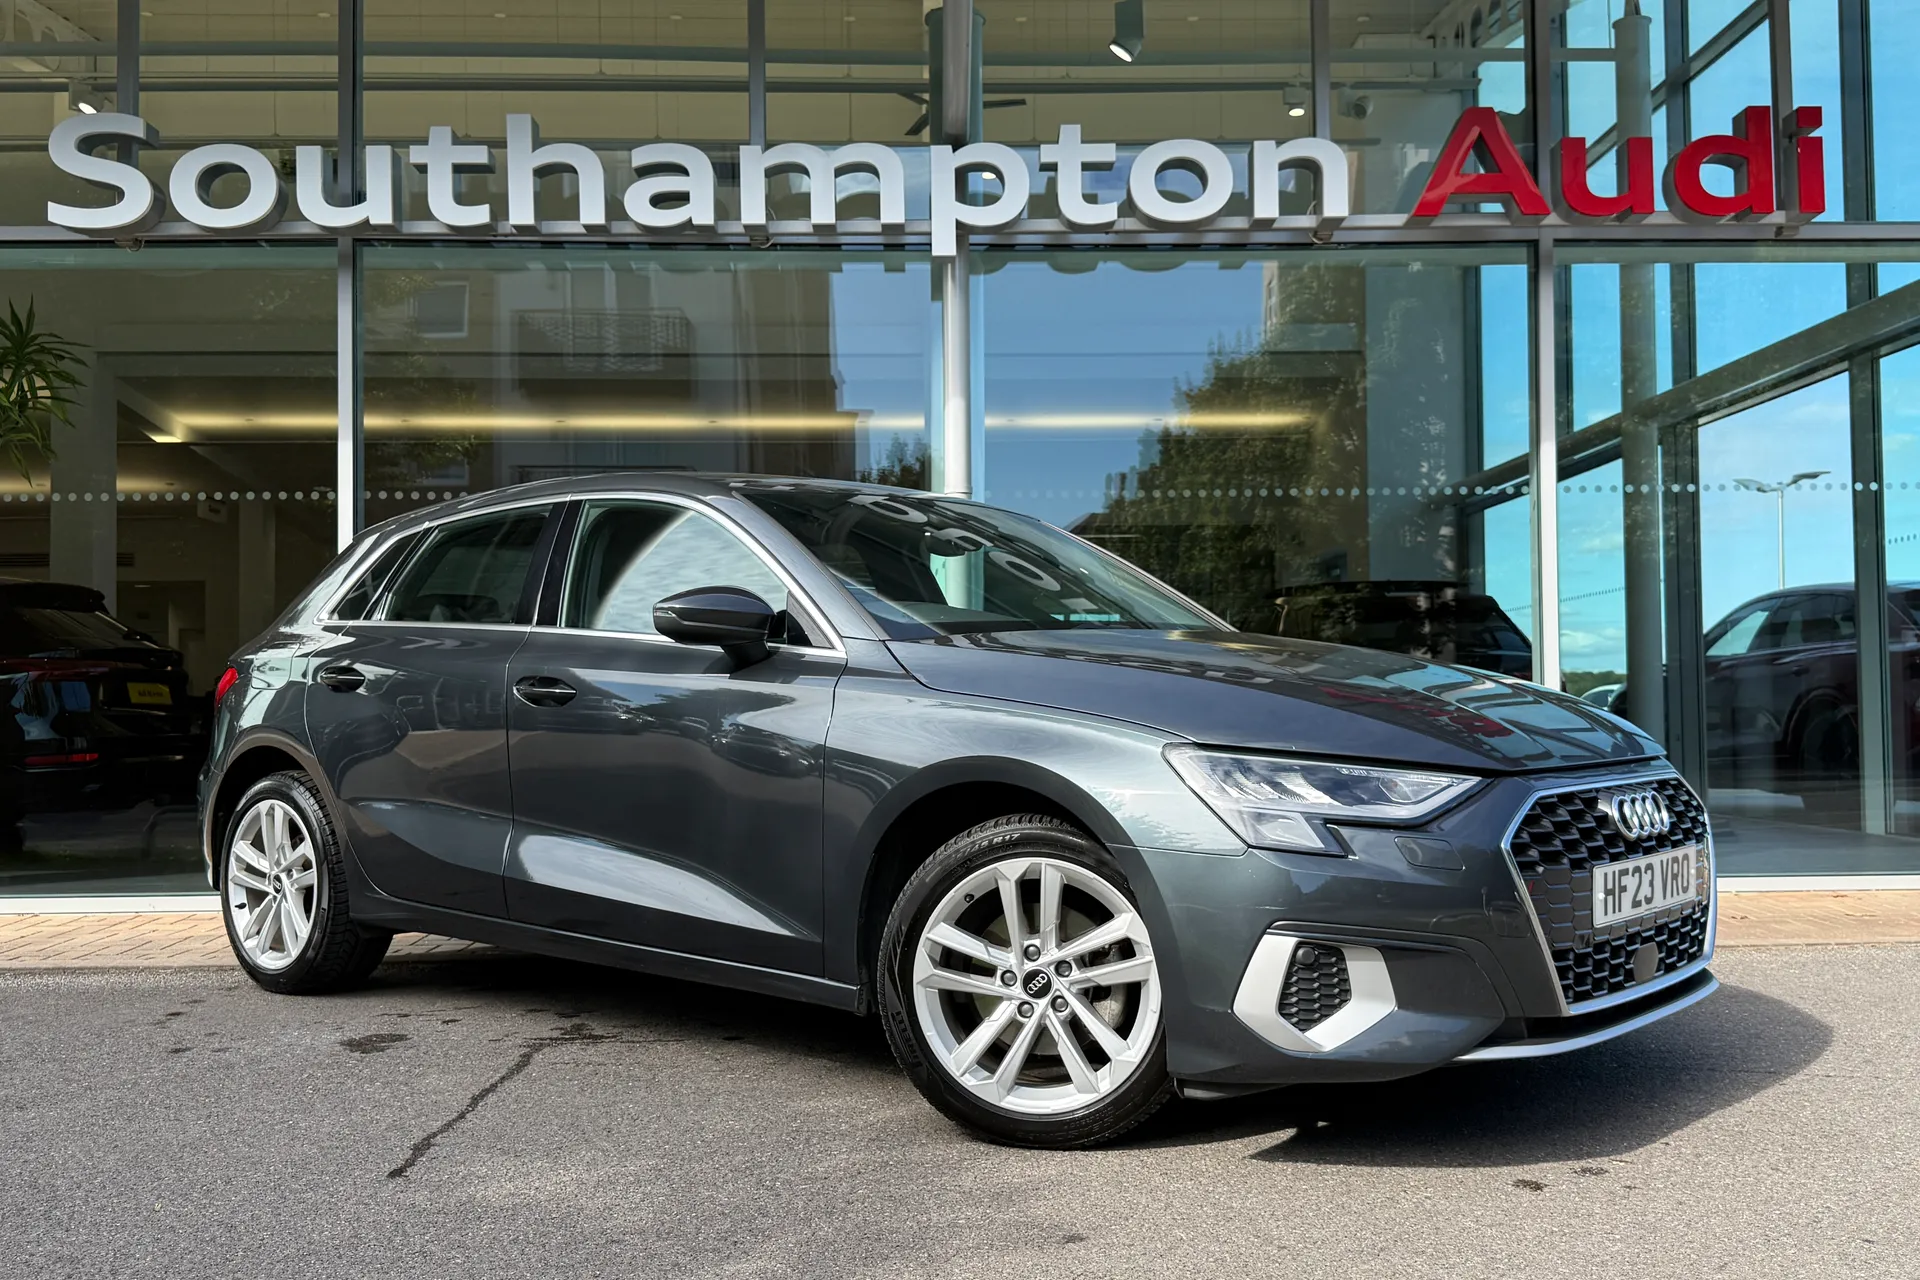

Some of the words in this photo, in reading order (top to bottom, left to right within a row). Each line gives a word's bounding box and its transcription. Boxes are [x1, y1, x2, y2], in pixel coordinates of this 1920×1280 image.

[47, 112, 1350, 257] Southampton
[1411, 105, 1826, 219] Audi
[1603, 862, 1655, 916] HF23
[1660, 853, 1690, 900] VRO
